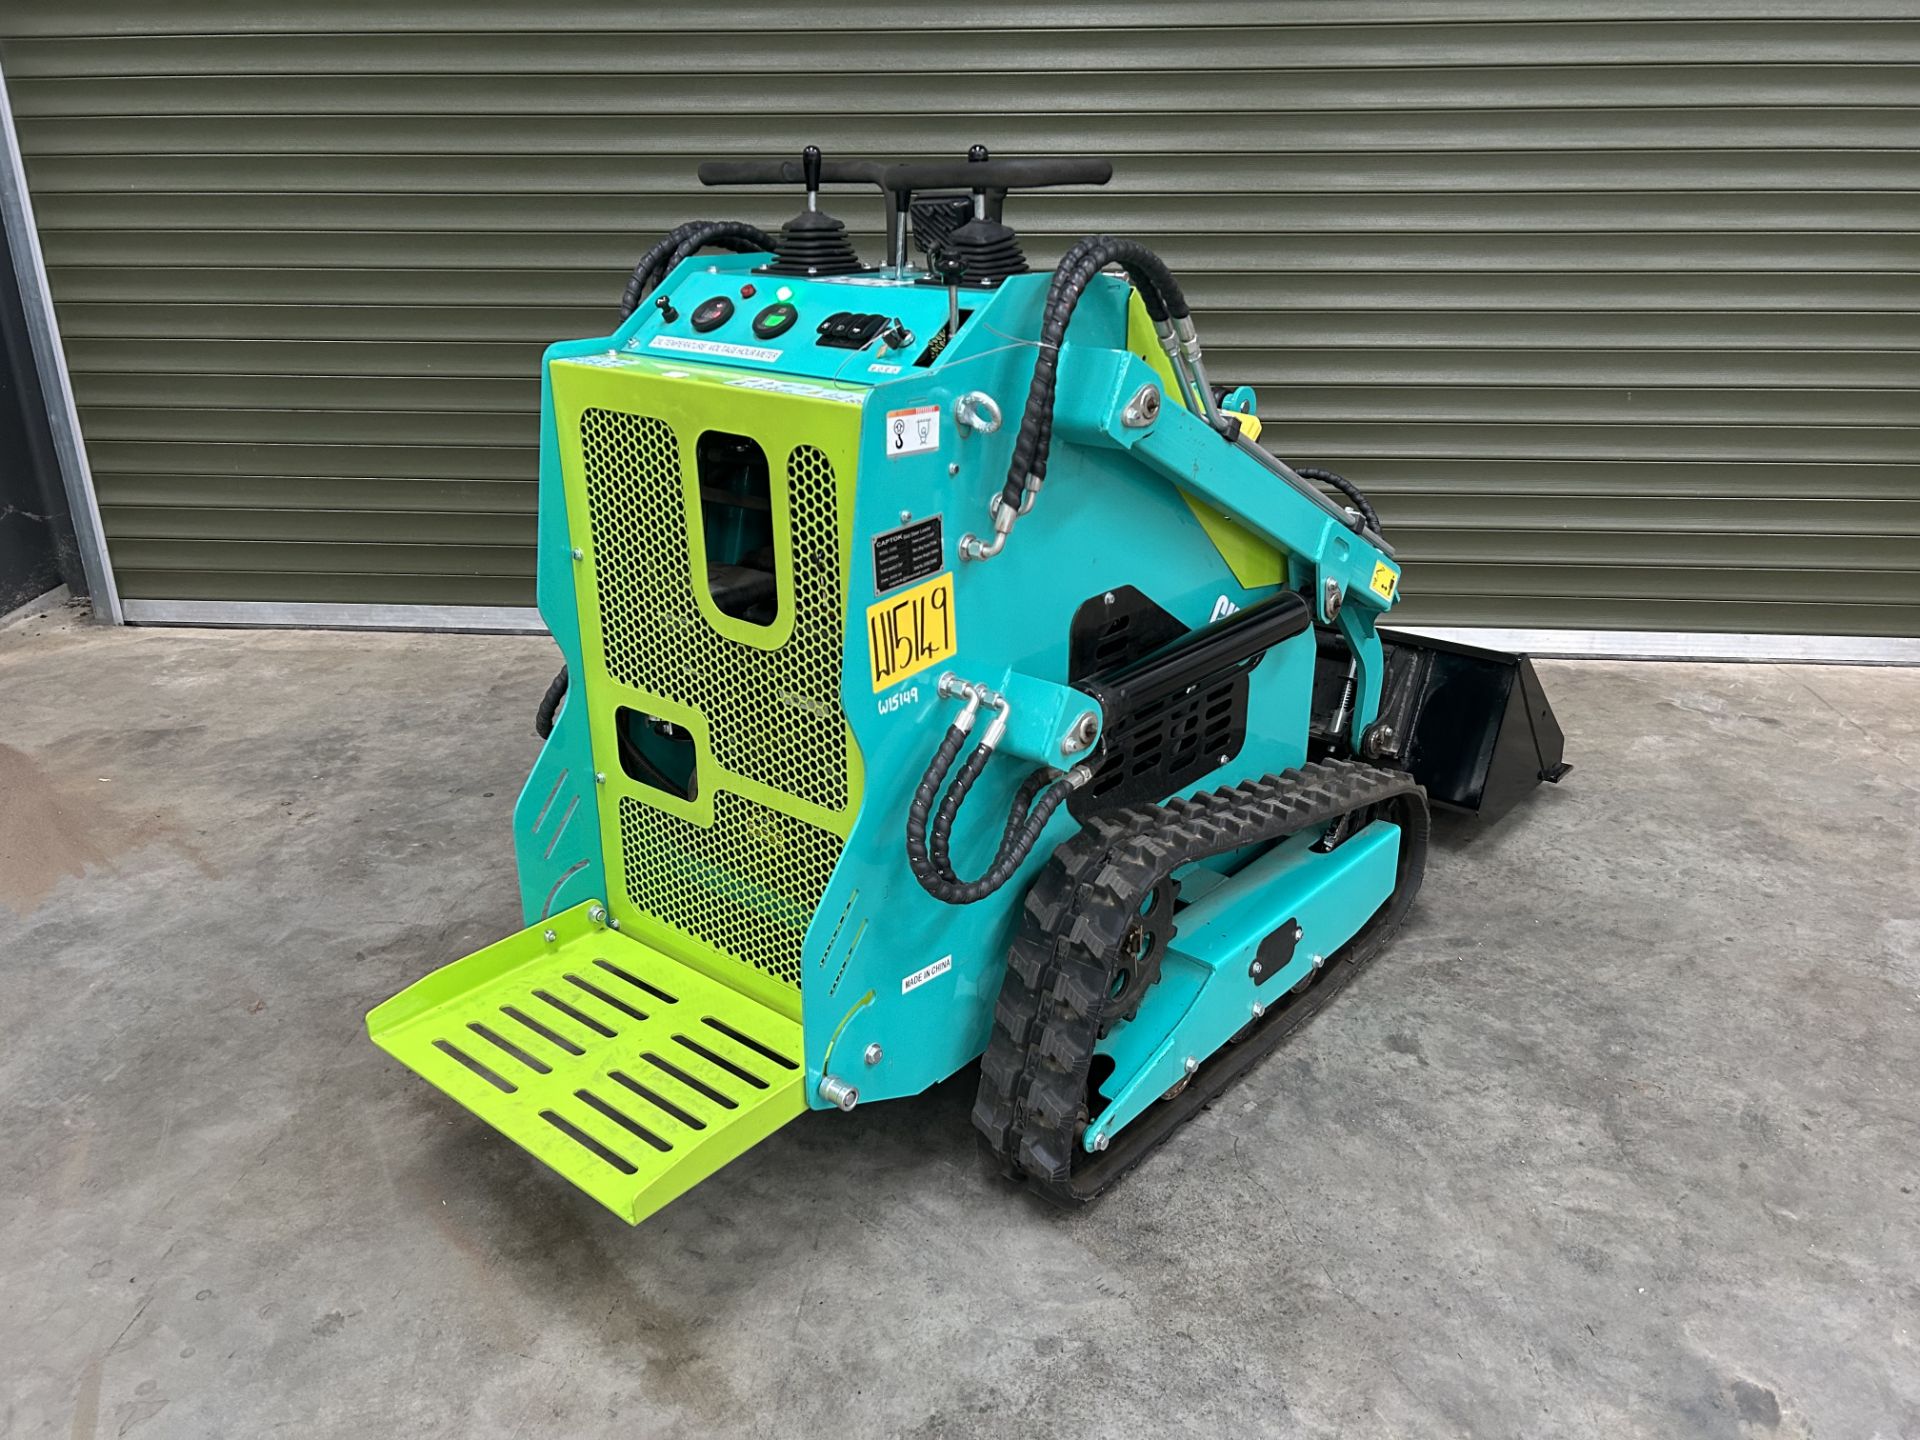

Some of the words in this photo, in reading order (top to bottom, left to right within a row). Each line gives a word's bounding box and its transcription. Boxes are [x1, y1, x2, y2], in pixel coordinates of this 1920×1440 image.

[870, 586, 948, 682] W15149
[878, 686, 918, 716] W15149
[905, 973, 922, 988] MADE
[930, 959, 950, 976] CHINA
